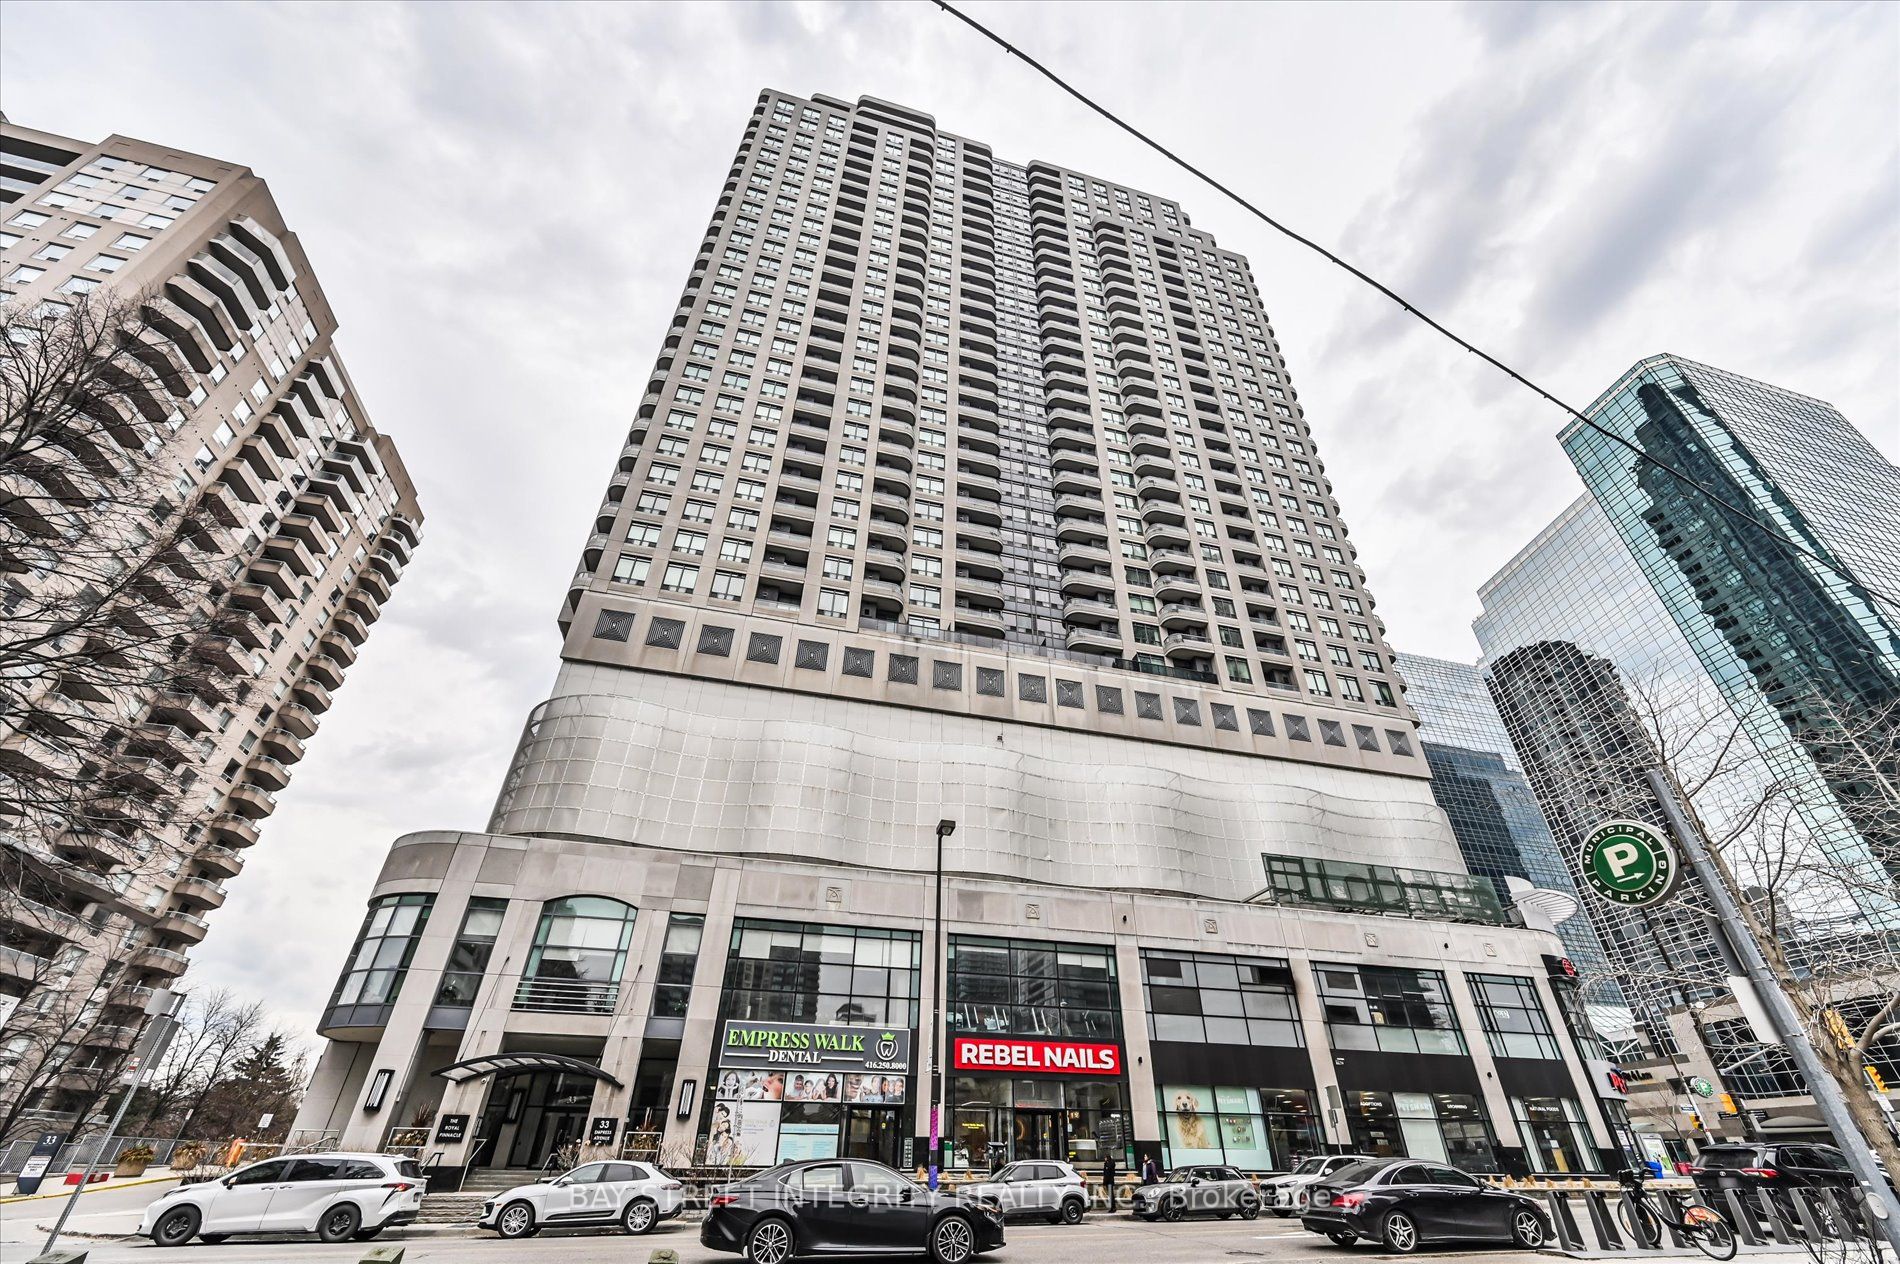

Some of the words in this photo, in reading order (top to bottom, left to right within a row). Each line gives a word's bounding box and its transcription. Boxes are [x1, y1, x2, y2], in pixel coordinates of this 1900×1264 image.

[1584, 826, 1653, 864] MUNICIPAL
[1603, 843, 1638, 878] P
[1592, 860, 1667, 901] PARKING
[727, 1029, 810, 1050] EMPRESS
[814, 1033, 865, 1052] WALK
[768, 1050, 822, 1064] DENTAL
[864, 1061, 907, 1070] 416.250.8000
[961, 1043, 1041, 1067] REBEL
[1044, 1047, 1115, 1070] NAILS
[599, 1120, 610, 1129] 33
[42, 1135, 58, 1145] 33
